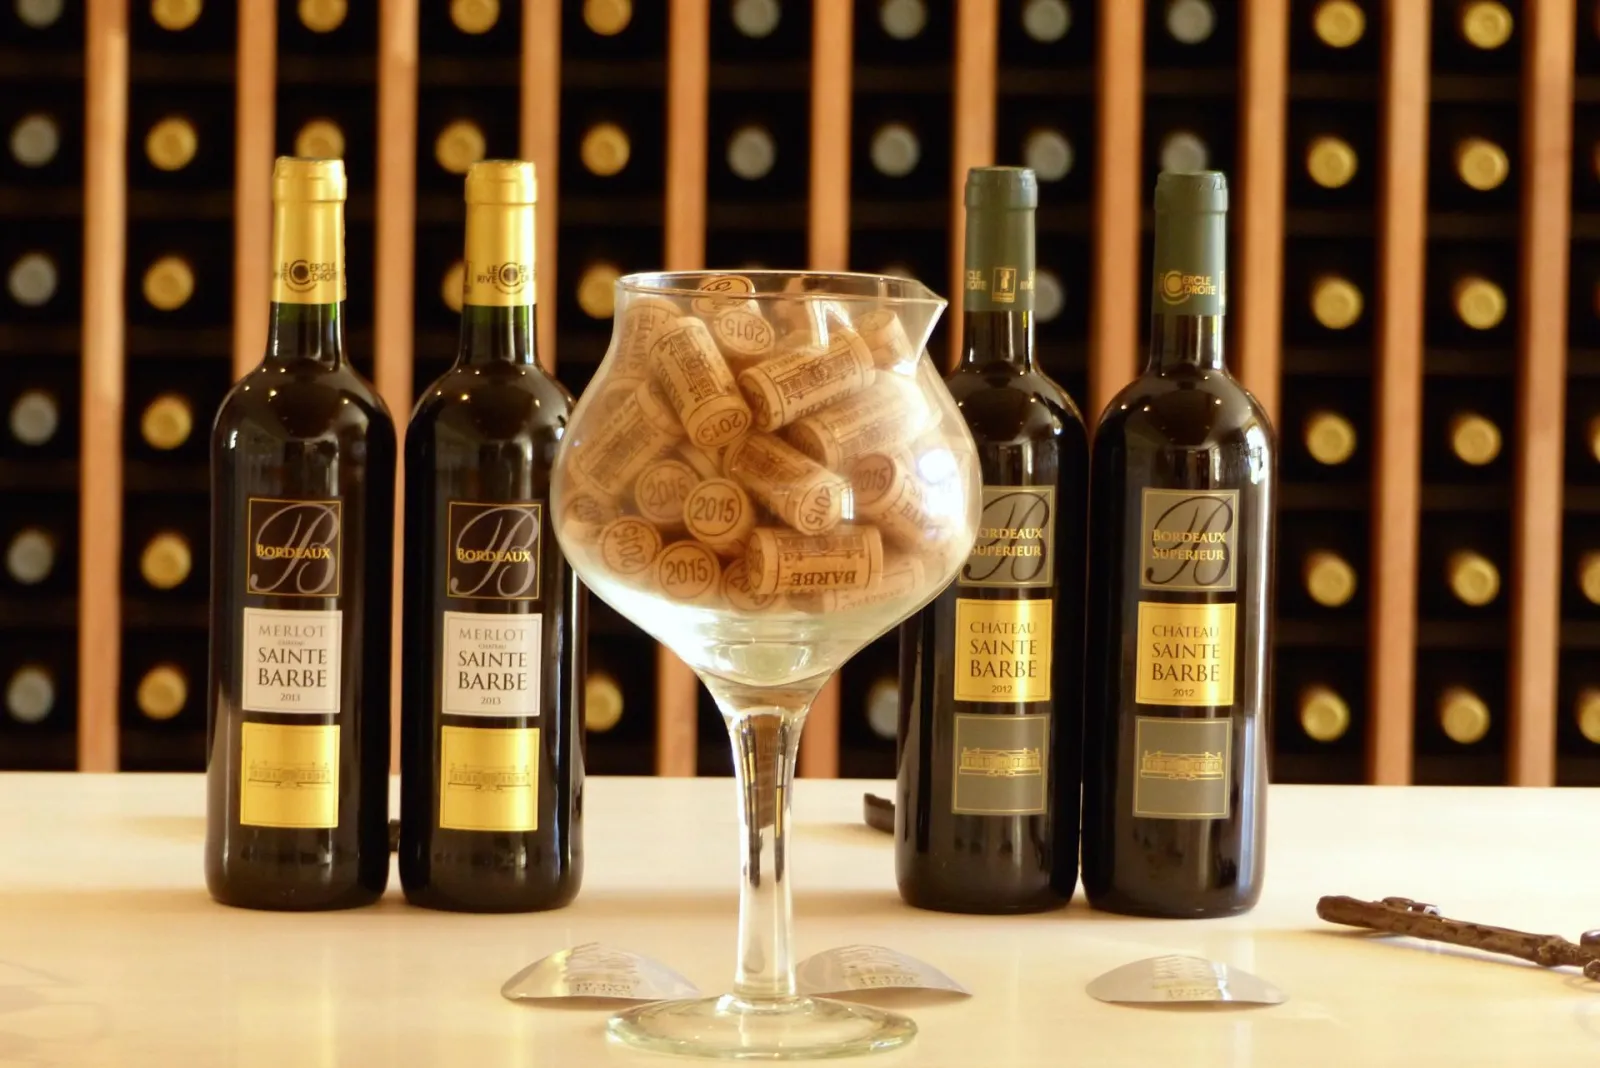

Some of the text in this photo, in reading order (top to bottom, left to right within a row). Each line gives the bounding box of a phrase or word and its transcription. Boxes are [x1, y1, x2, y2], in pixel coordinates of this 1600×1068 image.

[1184, 285, 1216, 296] DROITE
[725, 318, 765, 344] 2015
[701, 412, 743, 441] 2015
[693, 497, 735, 523] 2015
[978, 527, 1043, 540] ORDEAUX
[1152, 529, 1226, 543] BORDEAUX
[613, 525, 645, 568] 2015
[665, 558, 708, 585] 2015
[792, 571, 857, 586] BARBE
[258, 624, 327, 639] MERLOT
[458, 628, 526, 642] MERLOT
[258, 647, 327, 664] SAINTE
[970, 638, 1037, 656] SAINTE
[1152, 642, 1220, 659] SAINTE
[458, 651, 527, 668] SAINTE
[970, 659, 1037, 678] BARBE
[1152, 663, 1220, 682] BARBE
[258, 669, 327, 688] BARBE
[458, 672, 527, 691] BARBE
[280, 693, 301, 702] 2013
[991, 684, 1013, 694] 2012
[1173, 688, 1195, 697] 2012
[480, 696, 502, 706] 2013
